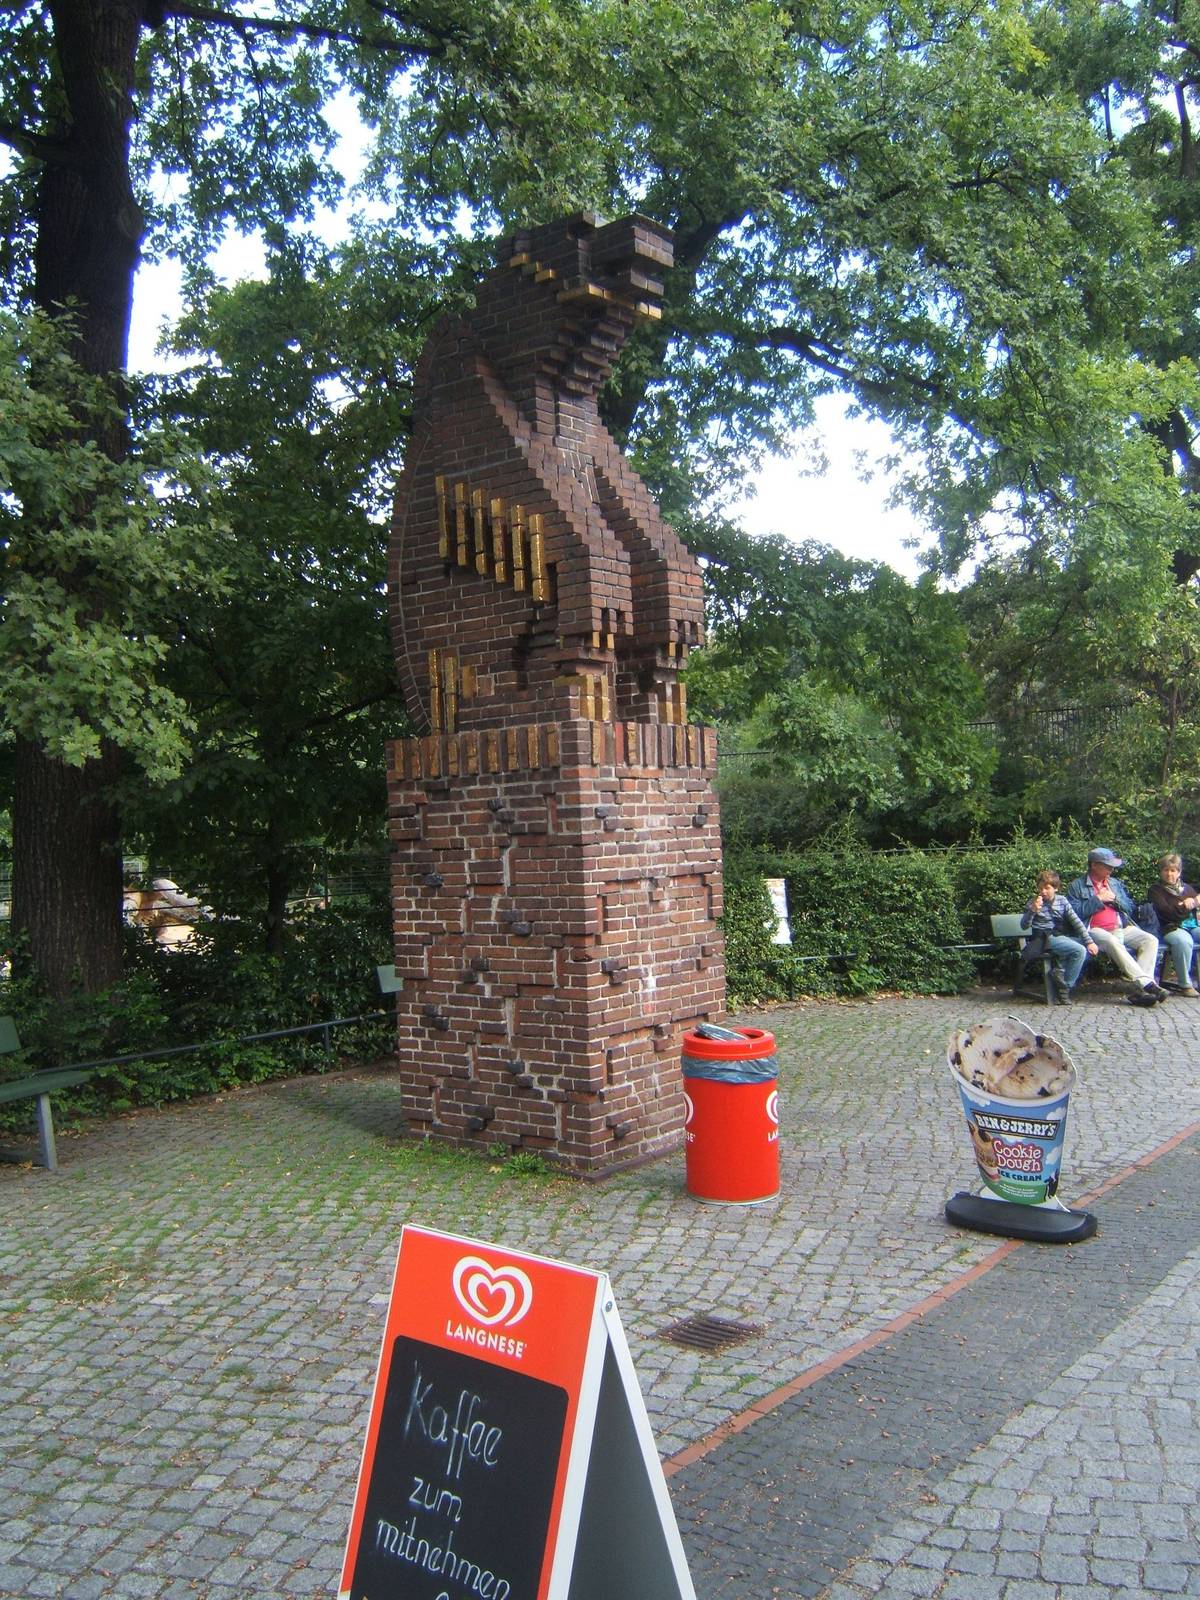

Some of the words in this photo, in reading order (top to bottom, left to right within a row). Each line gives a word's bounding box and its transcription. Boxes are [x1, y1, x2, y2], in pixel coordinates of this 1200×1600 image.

[994, 1140, 1041, 1159] Cookie
[996, 1153, 1041, 1172] Dough
[997, 1168, 1012, 1179] ICE
[1012, 1174, 1042, 1182] CREAM
[446, 1319, 525, 1359] LANGNESE
[405, 1362, 502, 1478] Kaffee
[408, 1476, 462, 1522] zum
[376, 1516, 510, 1600] mitnehmen
